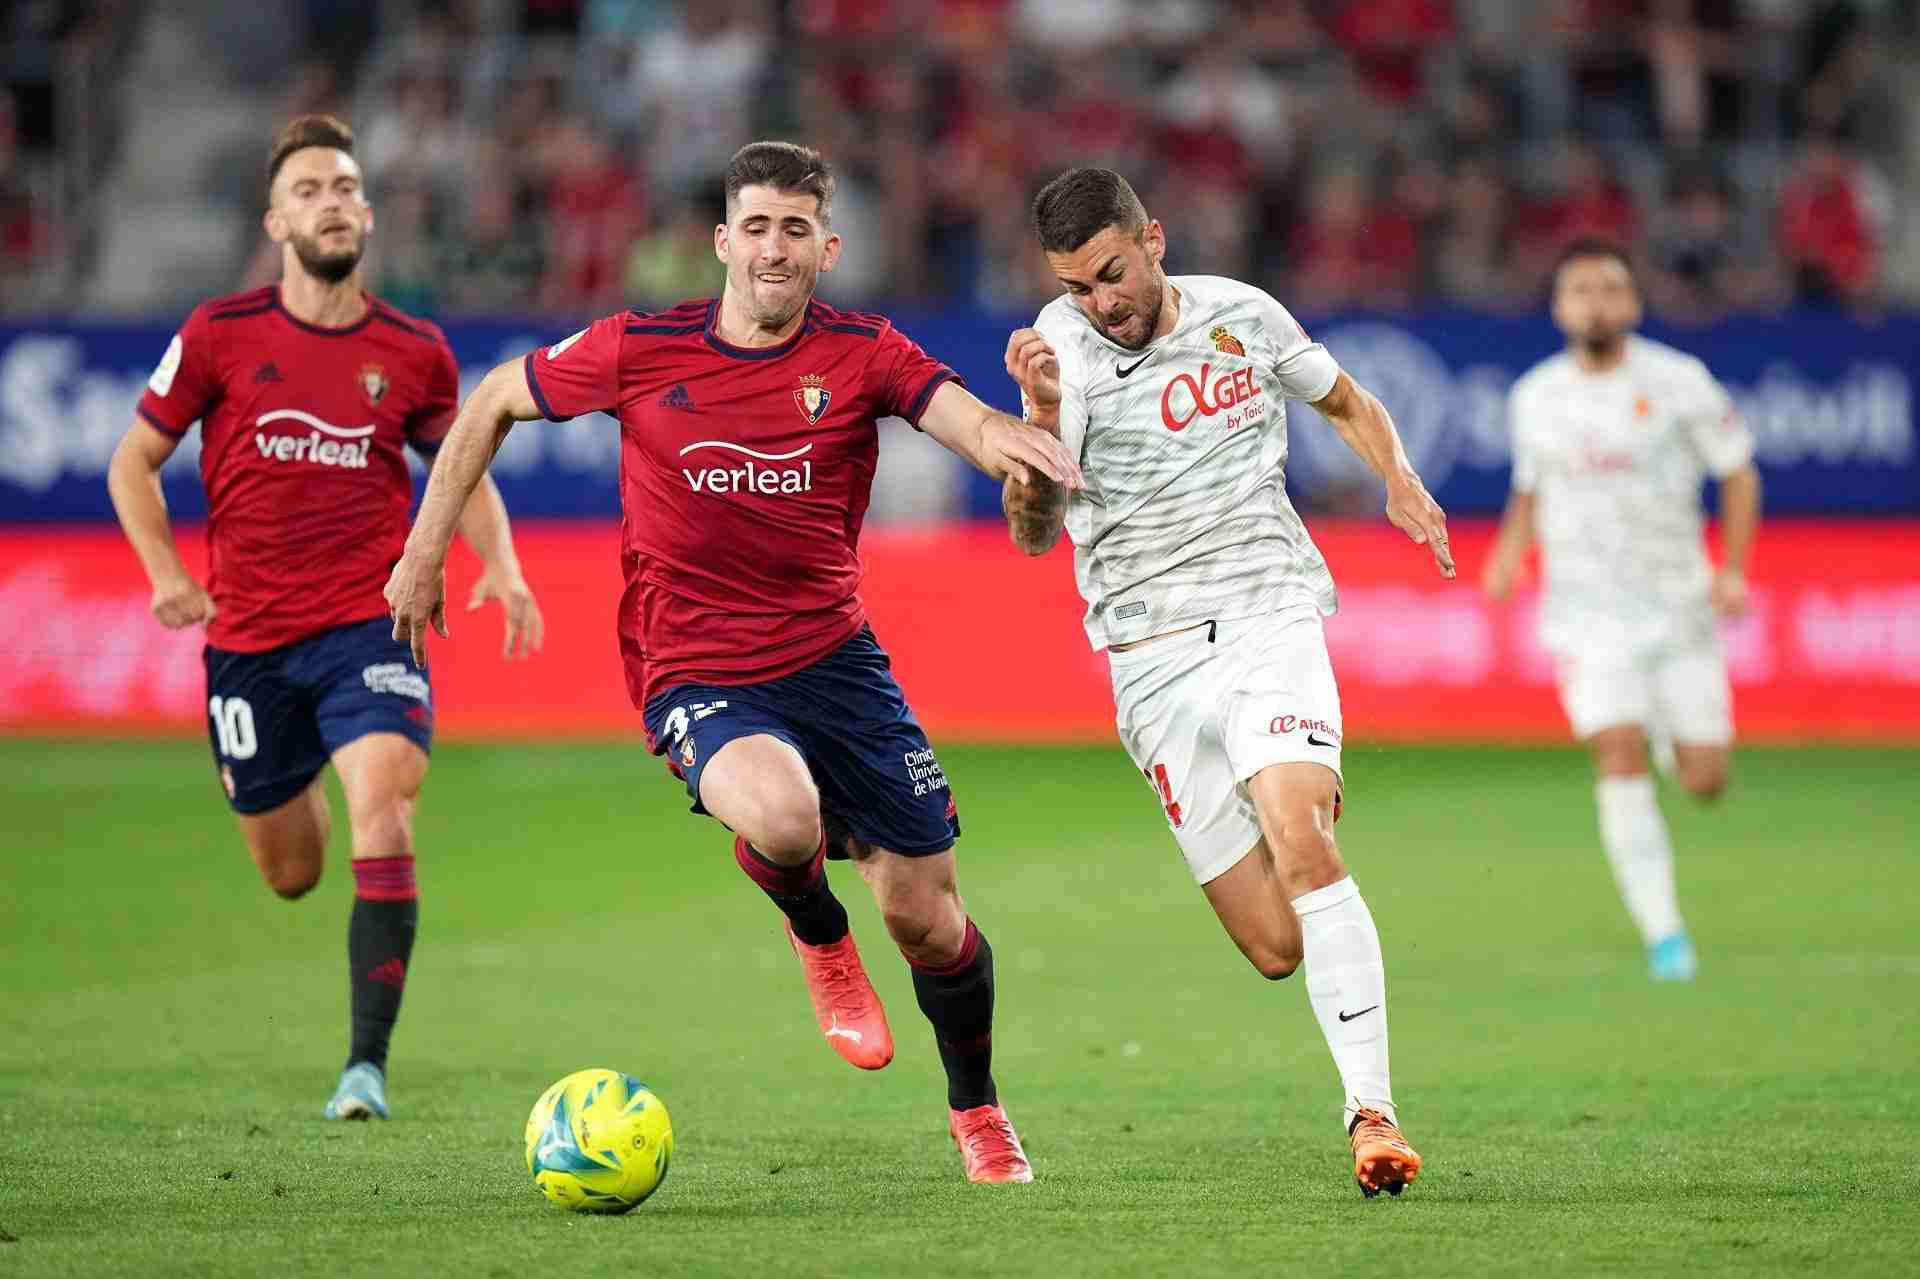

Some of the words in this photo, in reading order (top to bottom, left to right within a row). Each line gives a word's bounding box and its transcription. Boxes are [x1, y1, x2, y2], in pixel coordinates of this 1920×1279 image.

[1226, 415, 1241, 429] by
[255, 431, 370, 469] verleal
[682, 460, 812, 494] verleal
[209, 695, 257, 760] 10
[904, 748, 935, 767] Clínic
[908, 763, 943, 781] Unive
[915, 781, 928, 795] de
[927, 776, 948, 790] Nav
